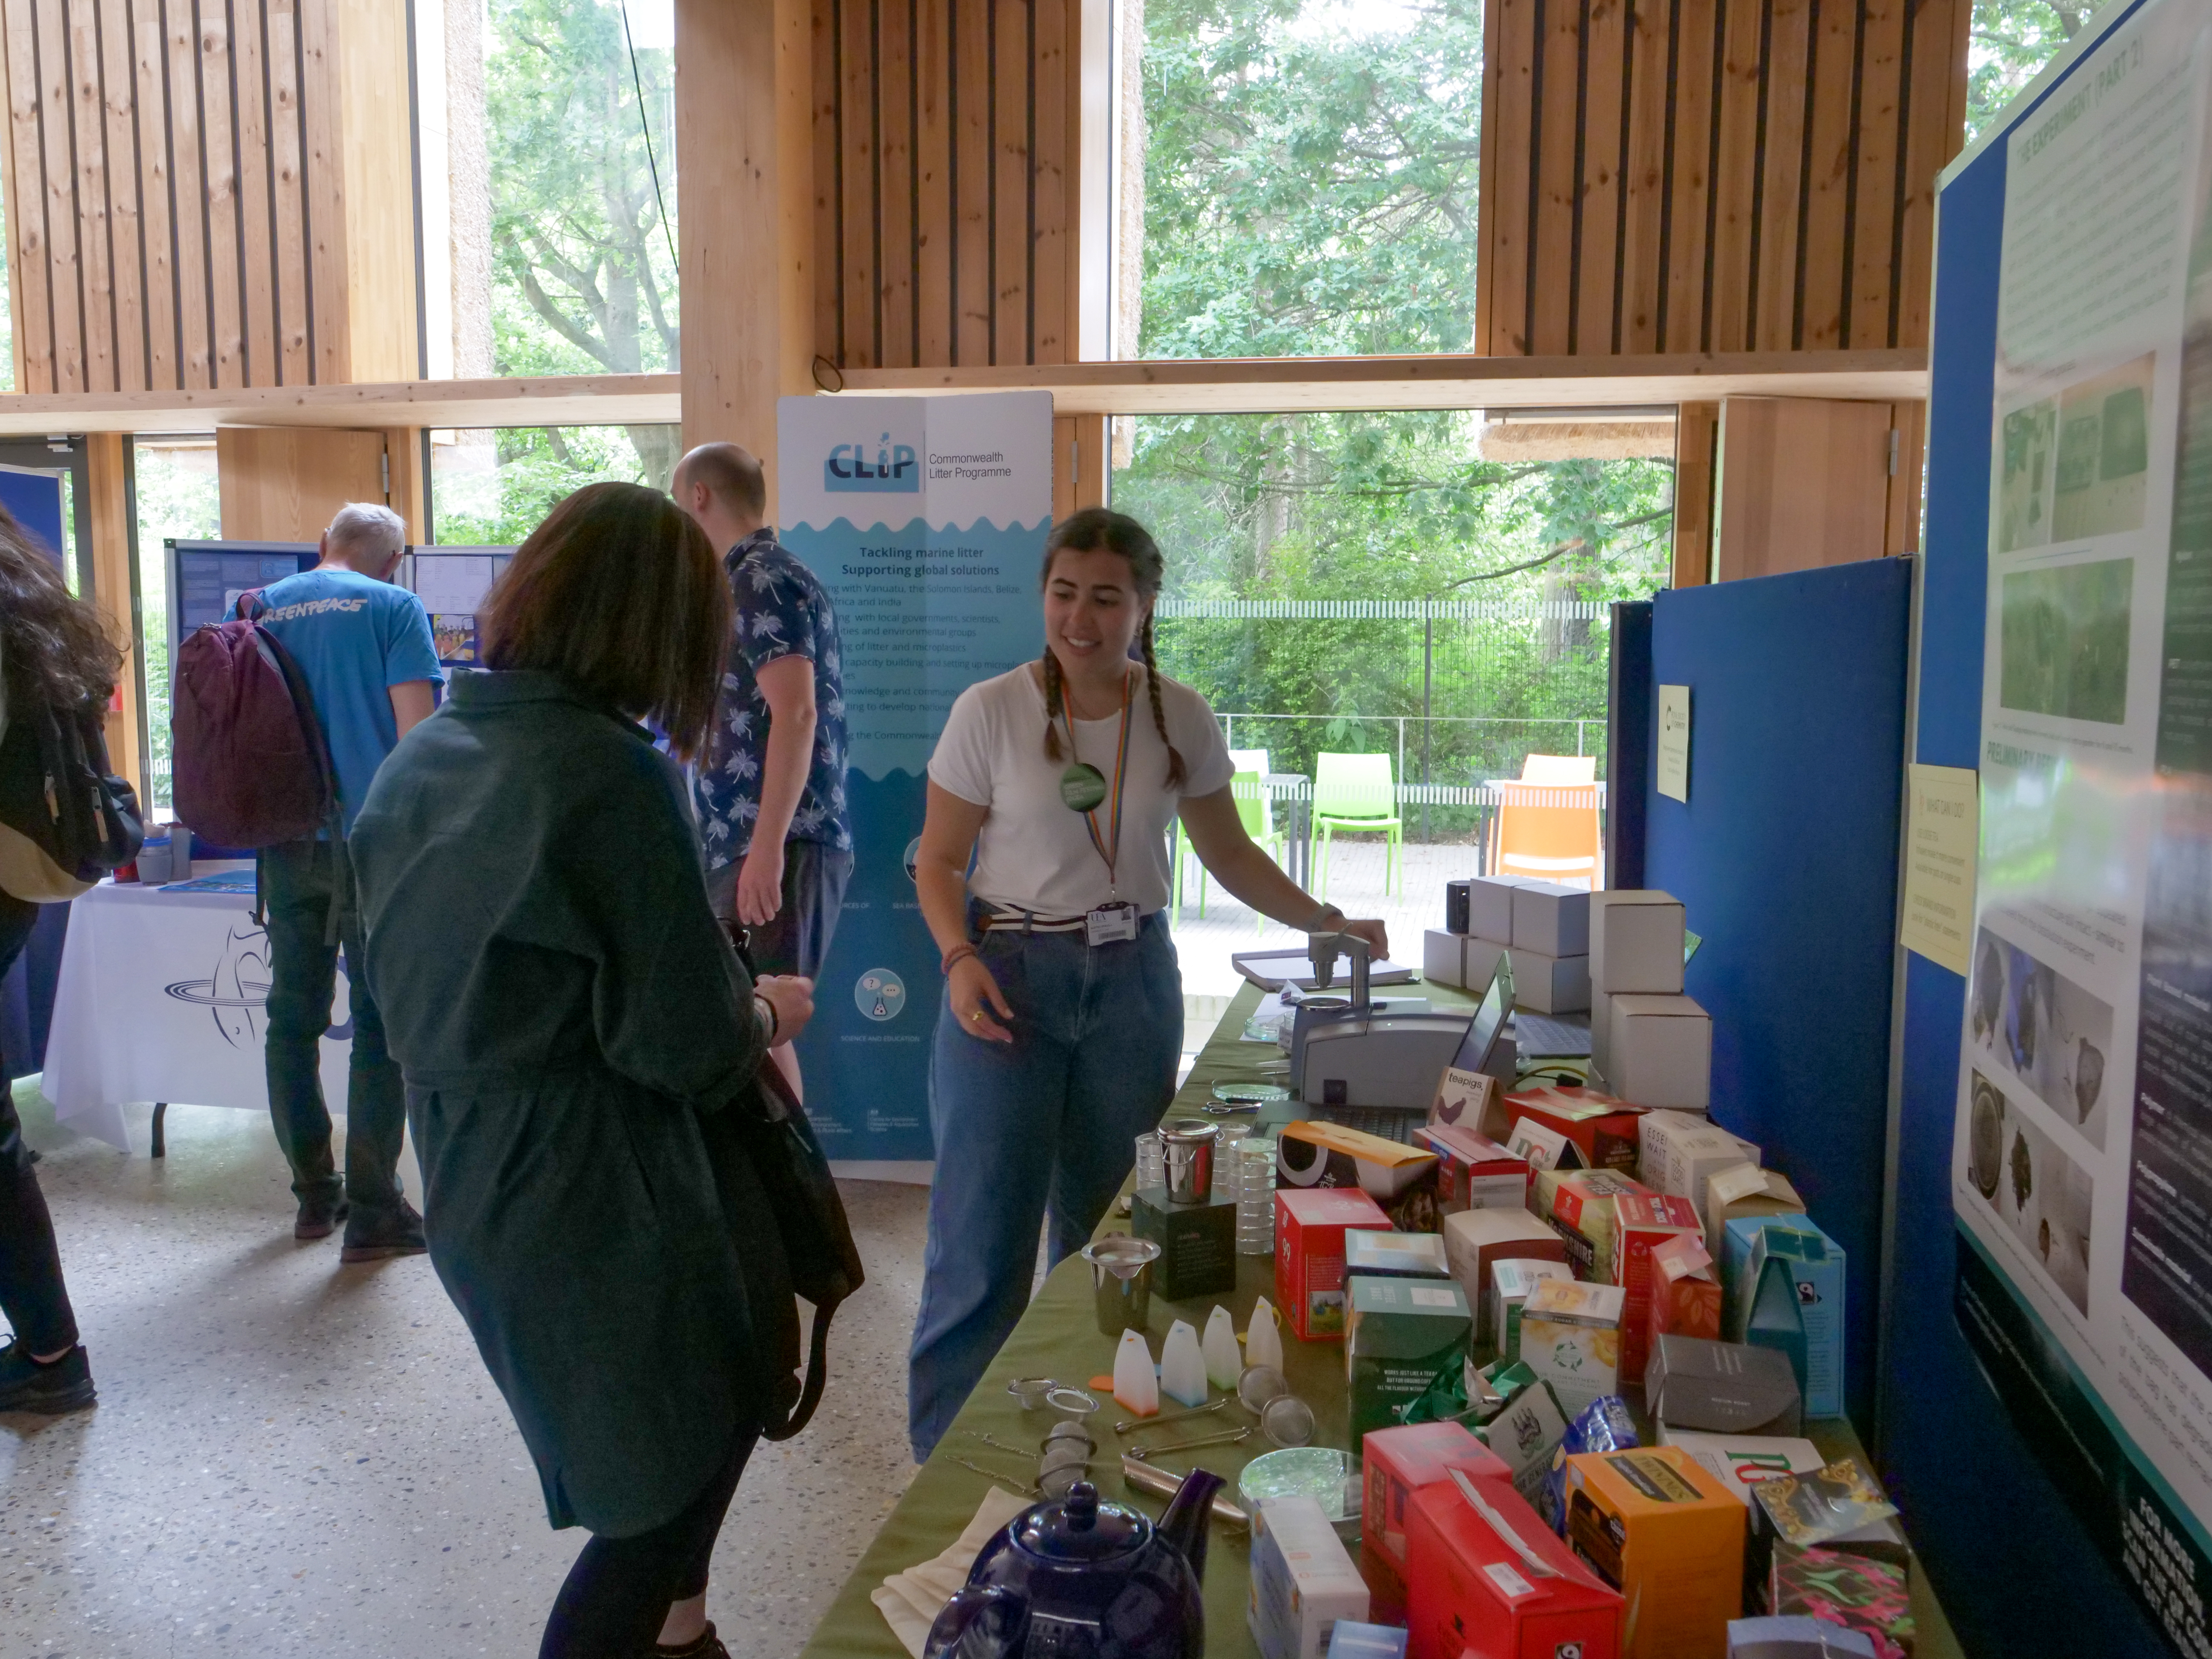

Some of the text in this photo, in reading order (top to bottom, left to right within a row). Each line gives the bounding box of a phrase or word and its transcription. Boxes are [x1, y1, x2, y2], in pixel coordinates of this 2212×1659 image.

[929, 451, 1004, 465] Commonwealth
[929, 466, 1012, 480] Litter Programme
[859, 547, 984, 561] Tackling marine litter
[841, 564, 1000, 578] Supporting global solutions
[842, 584, 861, 593] with
[864, 585, 906, 594] Vanuatu,
[909, 585, 925, 593] the
[926, 585, 962, 594] Solomon
[963, 585, 994, 594] Islands,
[995, 585, 1022, 595] Belize,
[858, 598, 876, 606] and
[878, 598, 902, 606] India
[856, 614, 876, 622] with
[878, 614, 899, 622] local
[902, 614, 960, 624] governments,
[962, 615, 1001, 624] scientists,
[862, 627, 880, 635] and
[882, 627, 947, 636] environmental
[949, 629, 977, 638] groups
[856, 643, 865, 651] of
[867, 643, 889, 651] litter
[892, 643, 910, 652] and
[913, 643, 966, 653] microplastics
[845, 659, 883, 669] capacity
[886, 658, 924, 668] building
[943, 660, 970, 670] setting
[972, 661, 982, 670] up
[893, 687, 911, 695] and
[879, 702, 916, 712] develop
[856, 731, 871, 739] the
[1449, 1072, 1483, 1091] teapigs.
